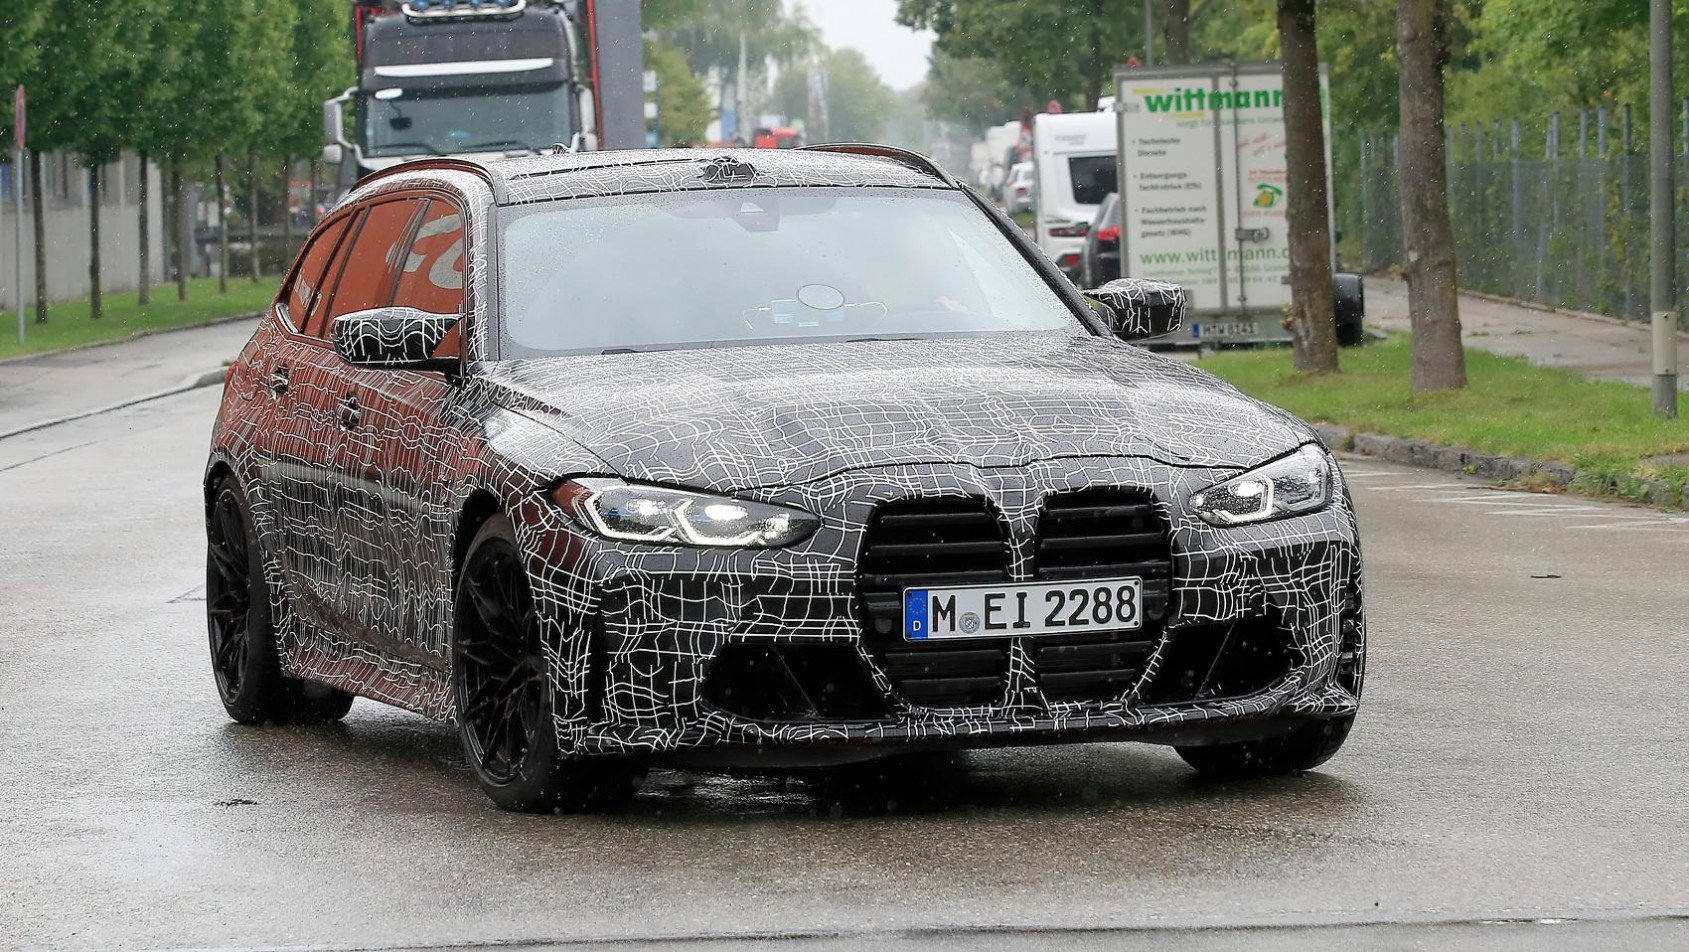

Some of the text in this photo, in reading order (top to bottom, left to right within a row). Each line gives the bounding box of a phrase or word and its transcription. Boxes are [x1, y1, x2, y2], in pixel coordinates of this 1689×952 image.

[932, 585, 1136, 633] M EI 2288
[912, 620, 922, 632] D
